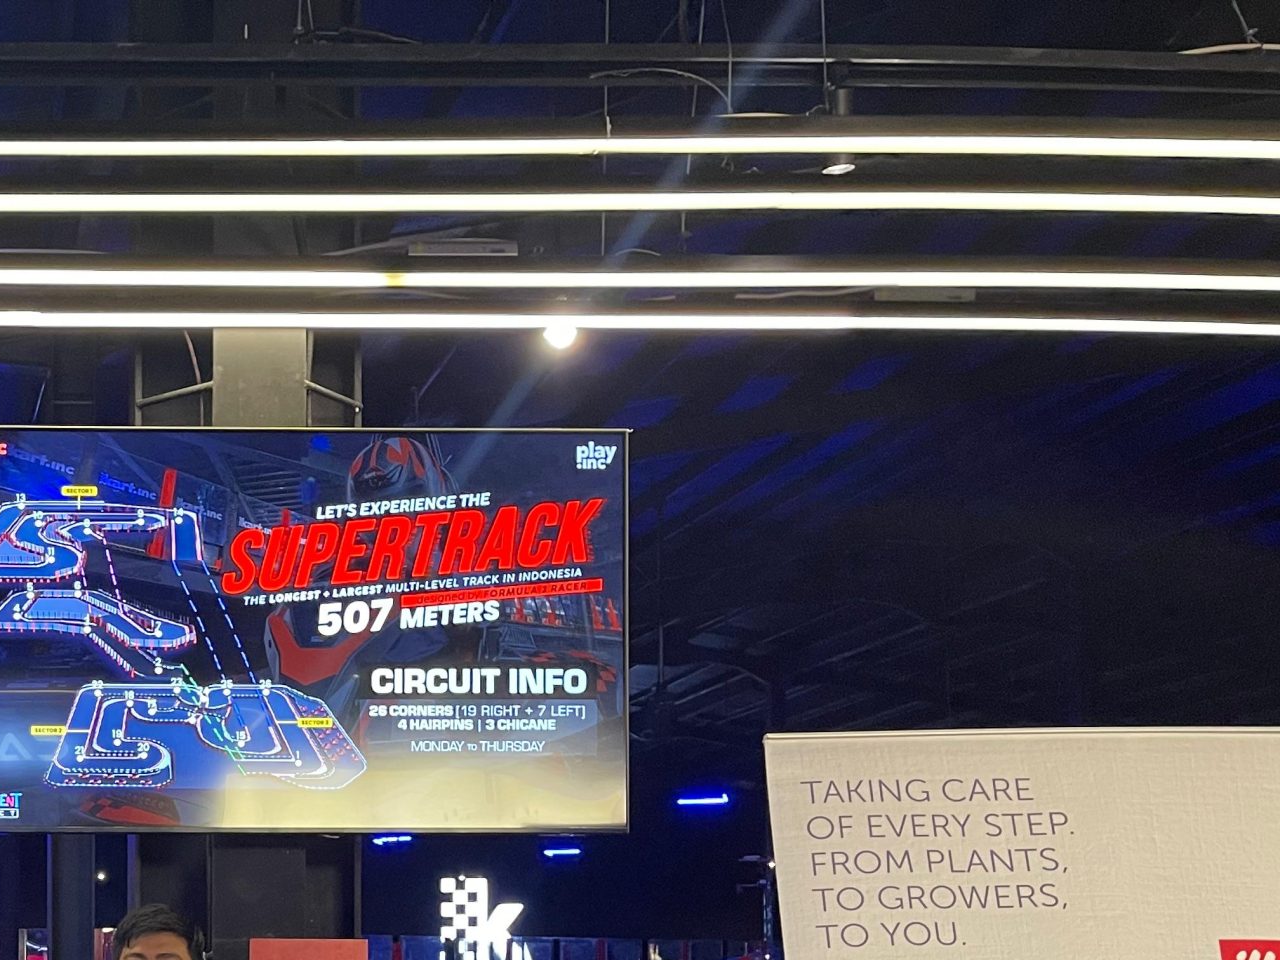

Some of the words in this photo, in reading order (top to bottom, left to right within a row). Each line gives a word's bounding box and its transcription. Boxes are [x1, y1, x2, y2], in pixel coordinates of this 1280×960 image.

[576, 441, 617, 466] play
[316, 503, 358, 520] LET'S
[359, 496, 458, 516] EXPERIENCE
[459, 492, 491, 508] THE
[221, 498, 605, 595] SUPERTRACK
[243, 595, 266, 606] THE
[268, 589, 321, 604] LONGEST
[332, 585, 384, 598] LARGEST
[385, 577, 459, 593] MULTI-LEVEL
[463, 575, 499, 586] TRACK
[503, 573, 515, 583] IN
[518, 568, 583, 581] INDONESIA
[484, 586, 537, 598] FORMULA
[550, 581, 588, 592] RACER
[317, 598, 394, 637] 507
[399, 600, 500, 630] METERS
[371, 668, 501, 694] CIRCUIT
[509, 668, 588, 694] INFO
[369, 705, 388, 717] 26
[389, 705, 454, 717] CORNERS
[481, 705, 520, 717] RIGHT
[538, 705, 546, 717] 7
[397, 719, 408, 730] 4
[409, 719, 474, 730] HAIRPINS
[485, 719, 495, 730] 3
[497, 719, 556, 730] CHICANE
[411, 741, 464, 752] MONDAY
[479, 741, 546, 752] THURSDAY
[800, 778, 930, 805] TAKING
[941, 777, 1034, 803] CARE
[806, 815, 854, 840] OF
[867, 813, 971, 839] EVERY
[984, 812, 1075, 838] STEP.
[811, 850, 913, 876] FROM
[927, 848, 1069, 876] PLANTS,
[812, 887, 865, 912] TO
[878, 883, 1069, 911] GROWERS,
[815, 923, 869, 949] TO
[880, 921, 967, 947] YOU.
